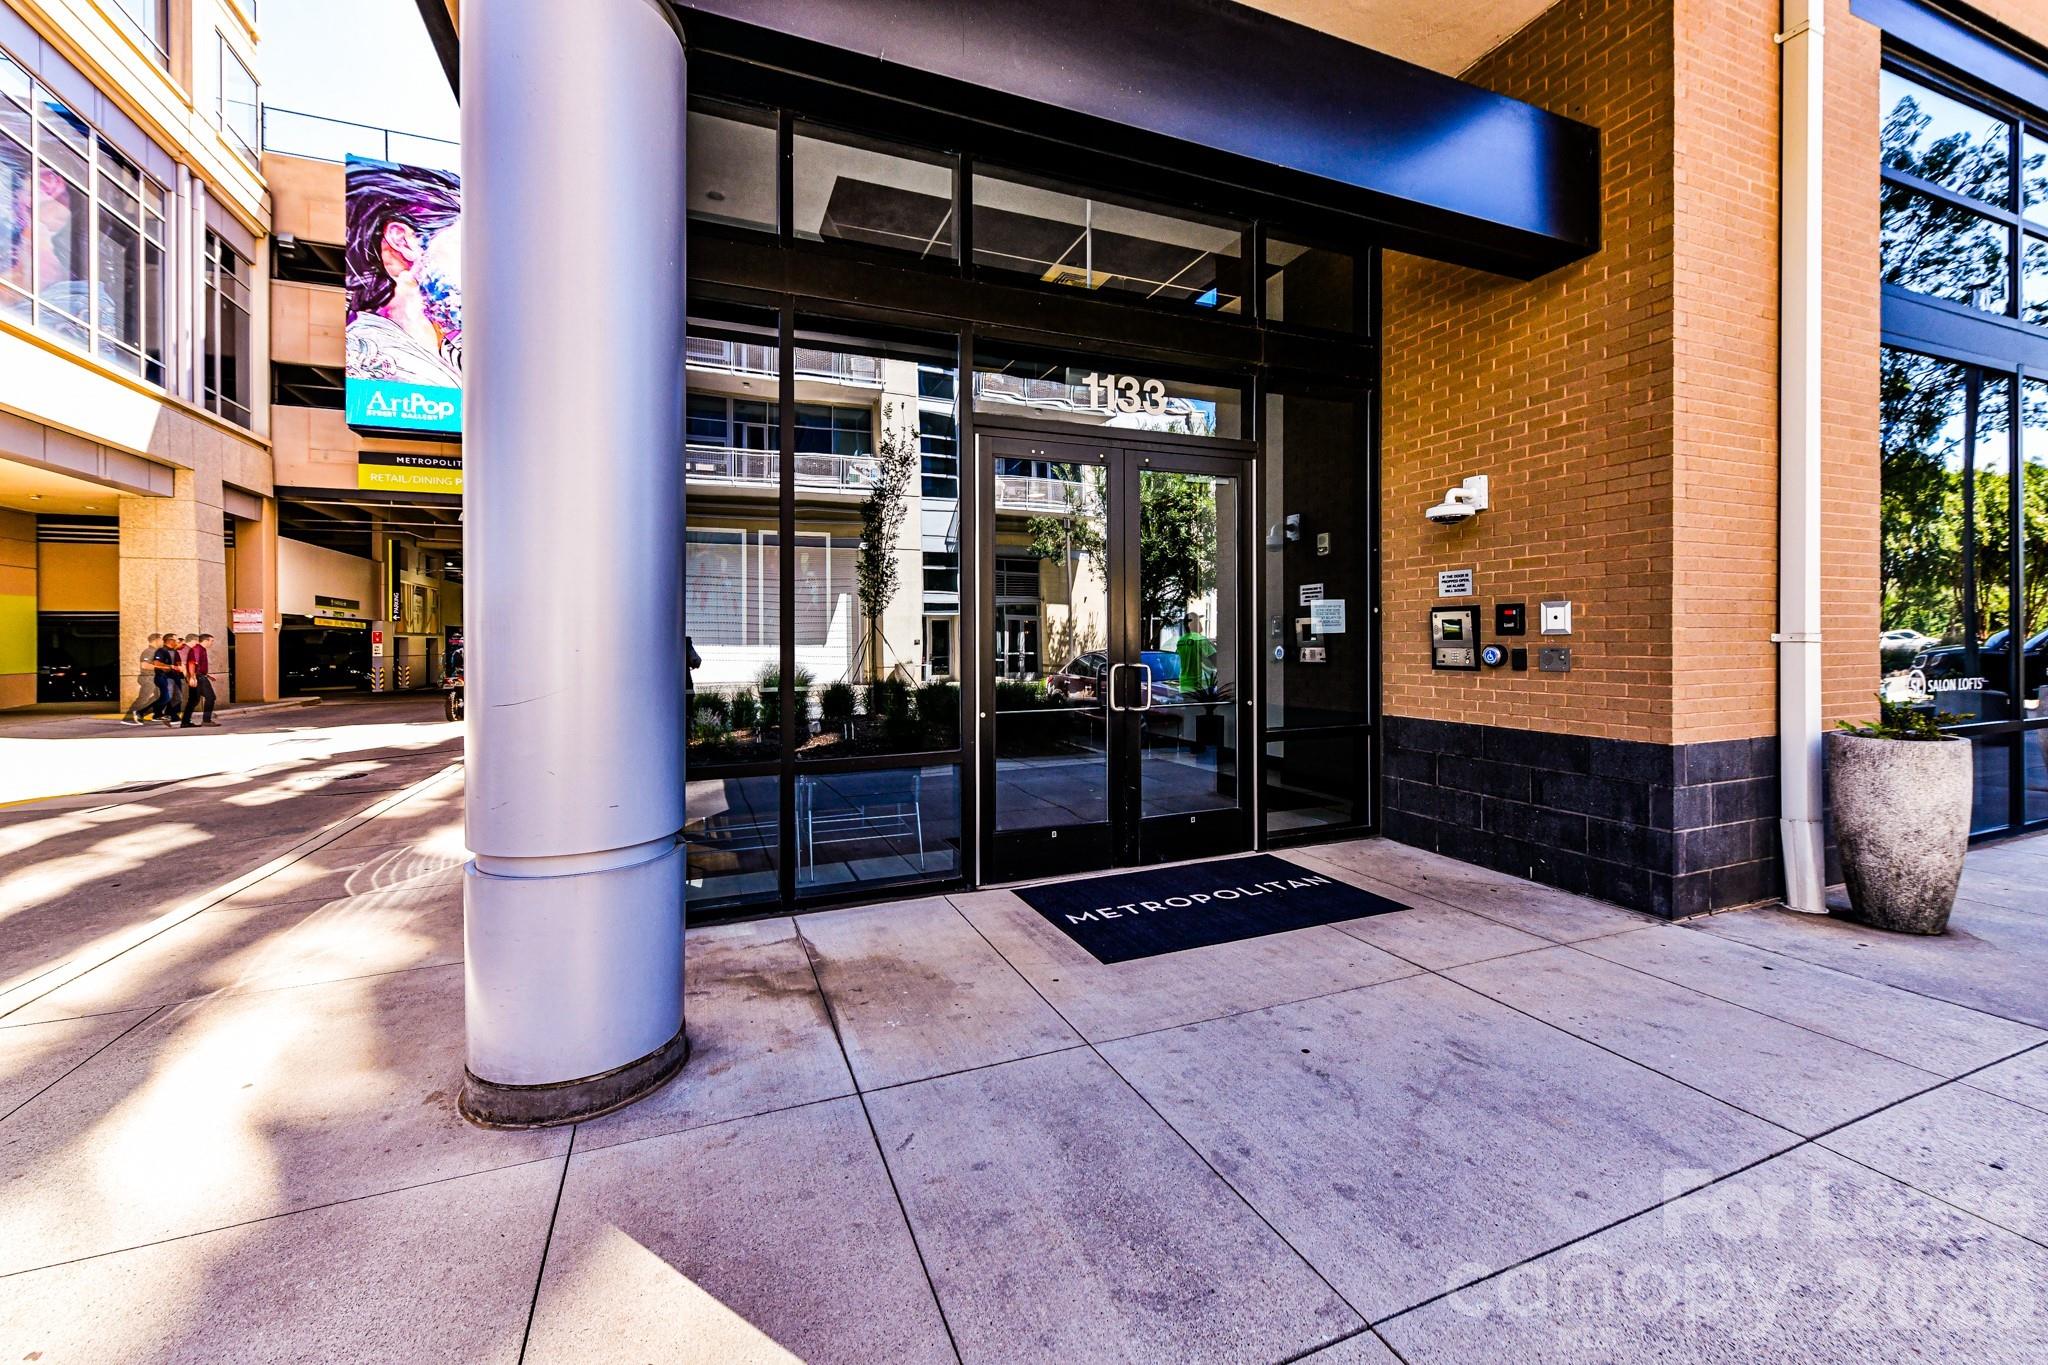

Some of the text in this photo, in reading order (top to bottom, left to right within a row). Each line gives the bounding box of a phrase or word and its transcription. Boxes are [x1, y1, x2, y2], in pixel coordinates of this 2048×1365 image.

[367, 391, 455, 420] ArtPop
[1082, 373, 1166, 416] 1133
[370, 473, 452, 486] RETAIL/DINING
[1927, 679, 1956, 692] SALON
[1065, 875, 1333, 925] METROPOLITAN
